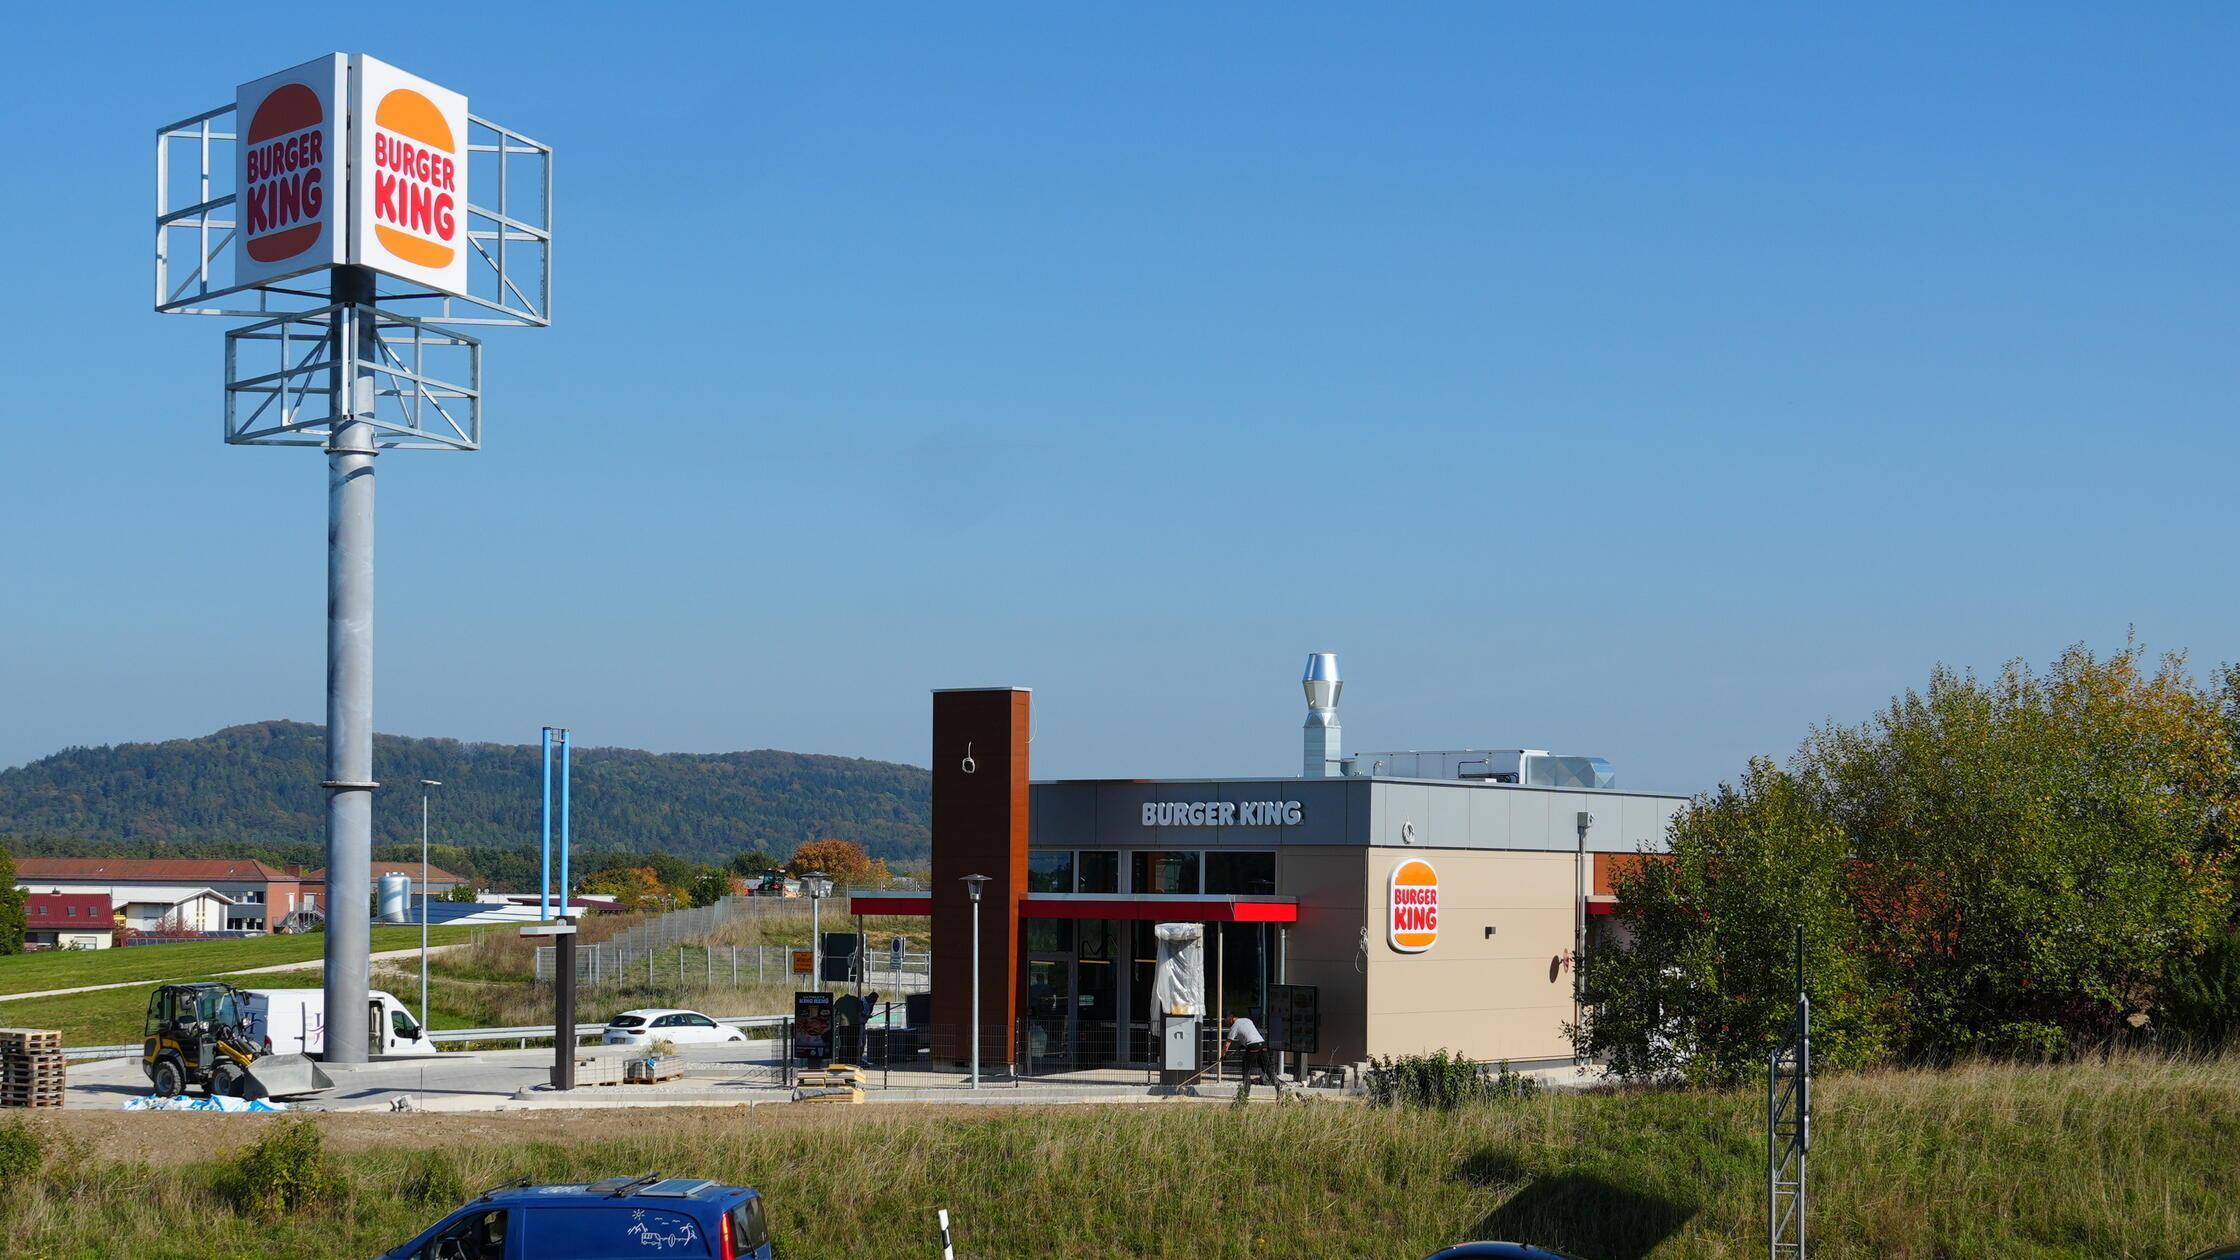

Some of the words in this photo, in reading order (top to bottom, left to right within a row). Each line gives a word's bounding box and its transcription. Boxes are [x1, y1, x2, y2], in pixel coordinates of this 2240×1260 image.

[247, 130, 323, 184] BURGER
[375, 132, 455, 192] BURGER
[247, 168, 322, 235] KING
[375, 169, 455, 241] KING
[1142, 801, 1236, 826] BURGER
[1240, 800, 1301, 826] KING
[1394, 888, 1437, 905] BURGER
[1394, 906, 1437, 930] KING
